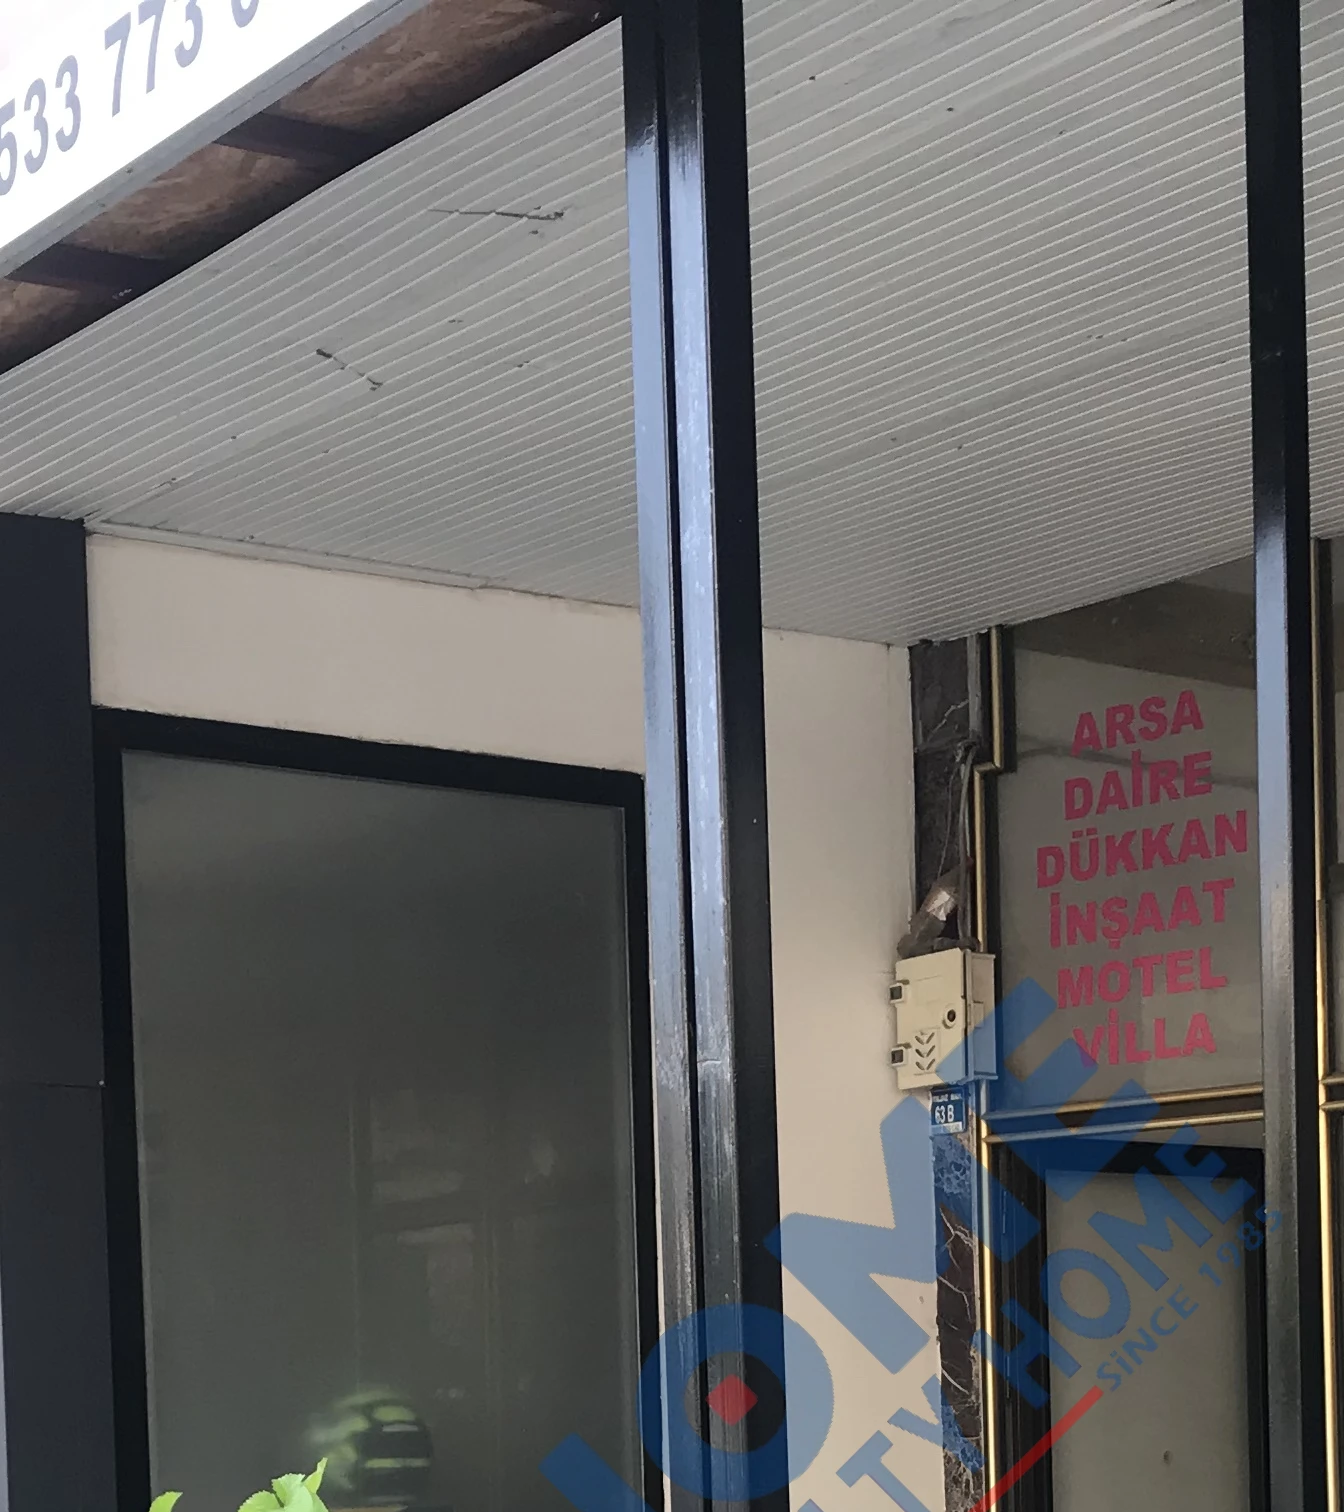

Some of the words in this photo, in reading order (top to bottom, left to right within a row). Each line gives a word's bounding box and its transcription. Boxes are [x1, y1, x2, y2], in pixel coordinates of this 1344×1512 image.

[103, 0, 204, 118] 773
[1070, 689, 1204, 757] ARSA
[1063, 749, 1213, 820] DAİRE
[1036, 810, 1248, 889] DÜKKAN
[1049, 878, 1236, 949] İNŞAAT
[1056, 946, 1228, 1009] MOTEL
[1072, 1008, 1217, 1066] VİLLA
